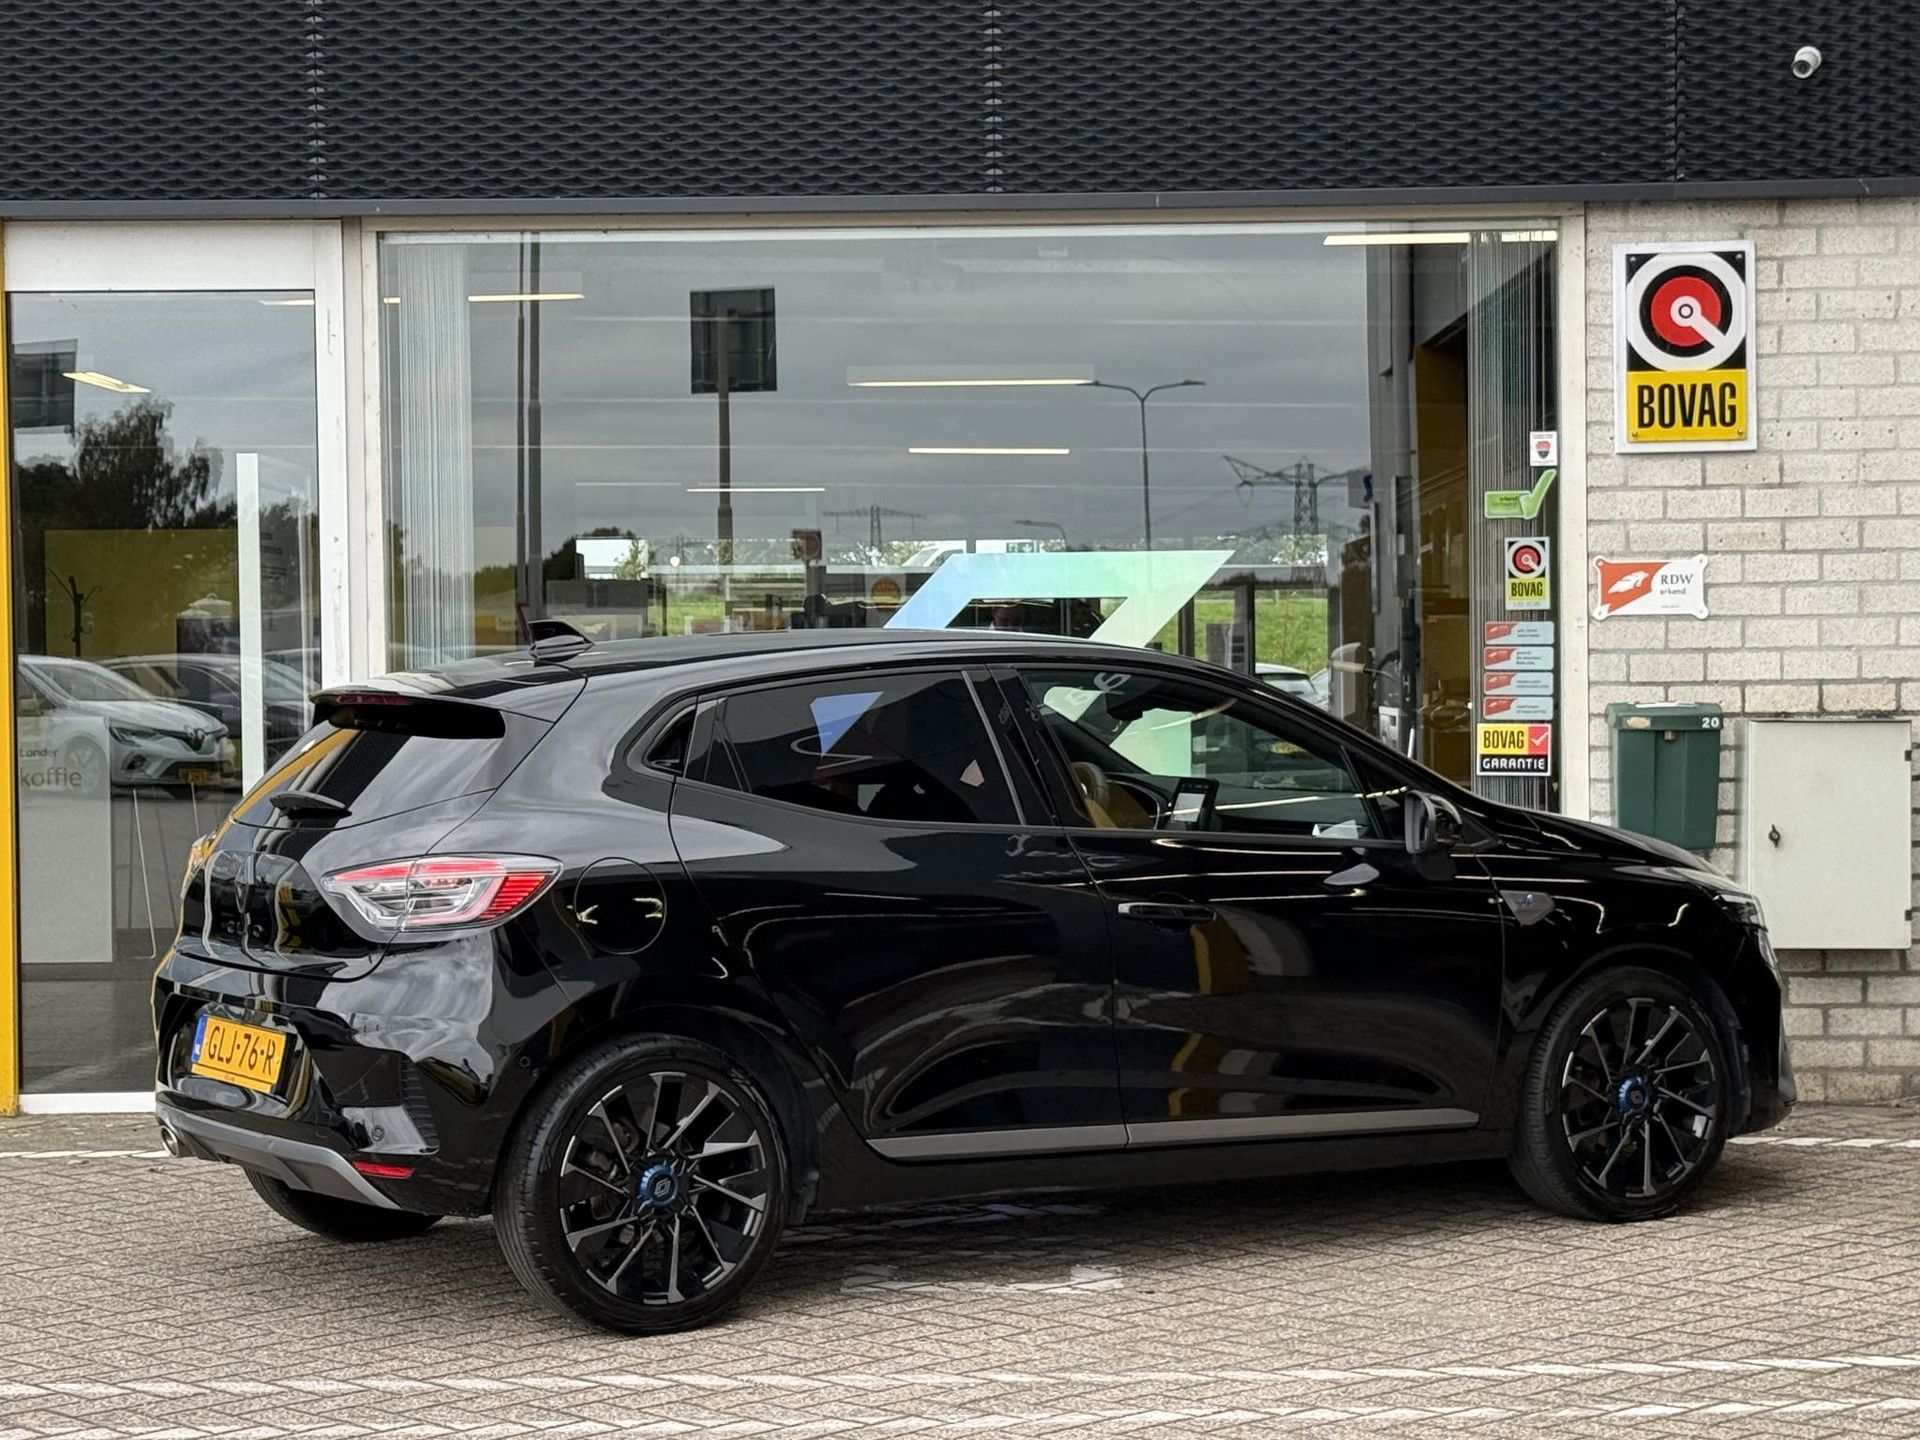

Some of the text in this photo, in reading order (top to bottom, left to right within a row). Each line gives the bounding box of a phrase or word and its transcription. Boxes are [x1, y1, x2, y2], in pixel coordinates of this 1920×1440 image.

[1637, 382, 1737, 429] BOVAG
[1660, 573, 1694, 585] RDW
[1511, 581, 1543, 597] BOVAG
[1660, 587, 1687, 595] erkend
[1701, 716, 1720, 729] 20
[1483, 730, 1525, 749] BOVAG
[1482, 757, 1546, 770] GARANTIE
[20, 766, 82, 787] koffie
[208, 1025, 276, 1075] GLJ-76-R
